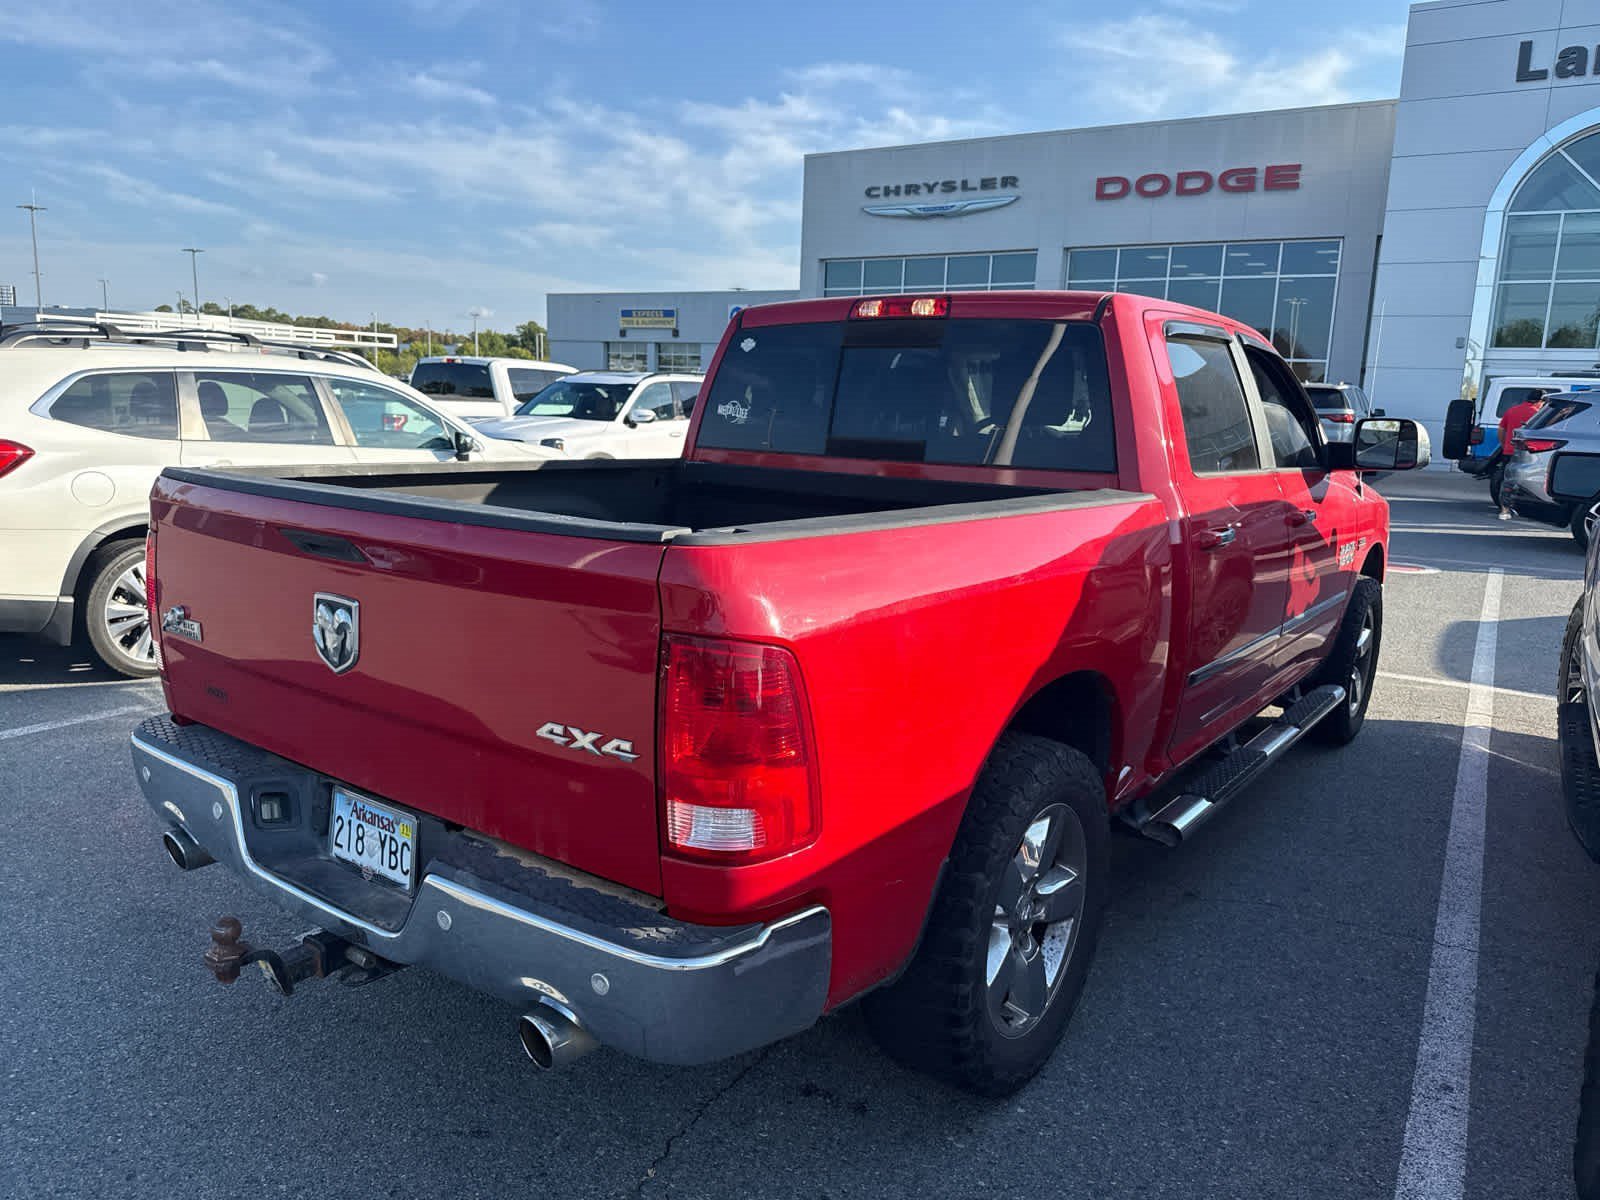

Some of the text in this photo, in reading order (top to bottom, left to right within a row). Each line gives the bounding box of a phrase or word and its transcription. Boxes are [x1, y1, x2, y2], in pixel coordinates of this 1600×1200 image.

[865, 176, 1019, 198] CHRYSLER
[1095, 164, 1302, 200] DODGE
[350, 800, 396, 834] Arkansas
[334, 815, 410, 876] 218 YBC
